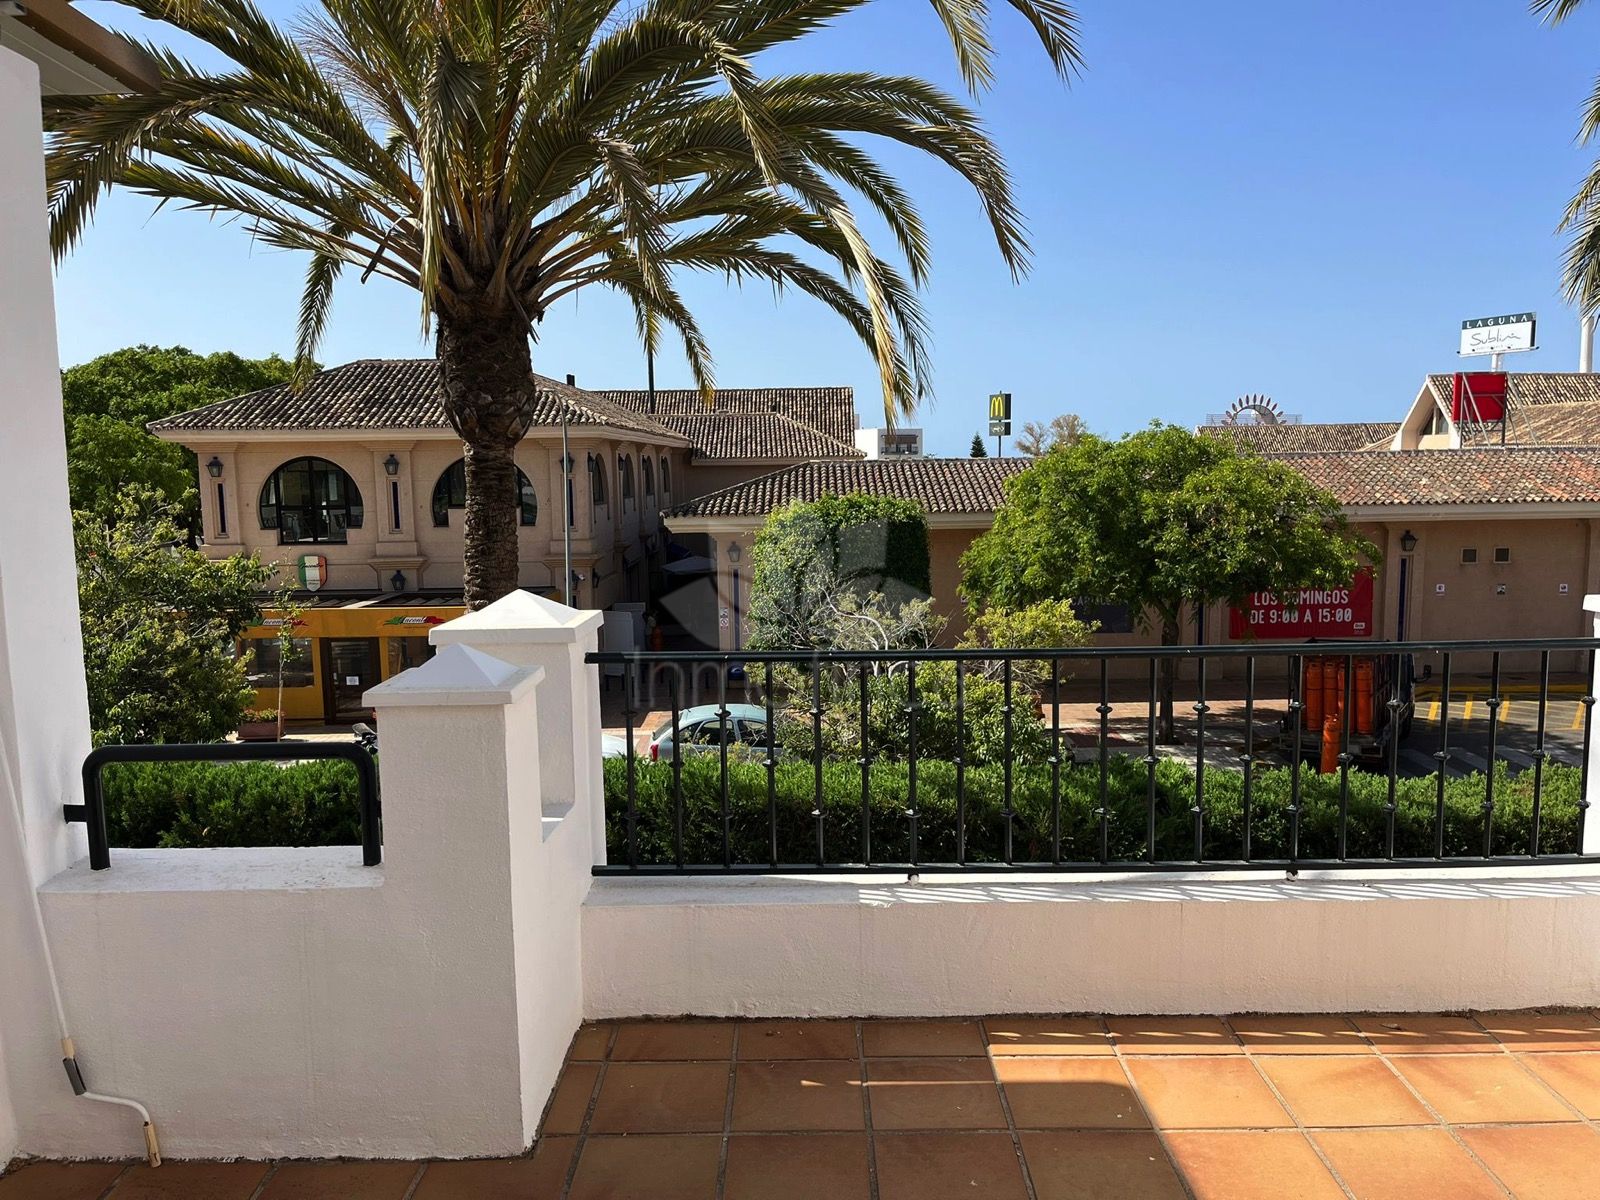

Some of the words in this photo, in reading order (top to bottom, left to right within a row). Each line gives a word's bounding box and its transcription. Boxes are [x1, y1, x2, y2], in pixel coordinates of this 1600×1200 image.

[1466, 314, 1528, 329] LAGUNA
[1254, 591, 1278, 606] LOS
[1250, 609, 1265, 624] DE
[1269, 609, 1299, 624] 9:00
[1303, 609, 1312, 623] A
[1318, 608, 1352, 623] 15:00
